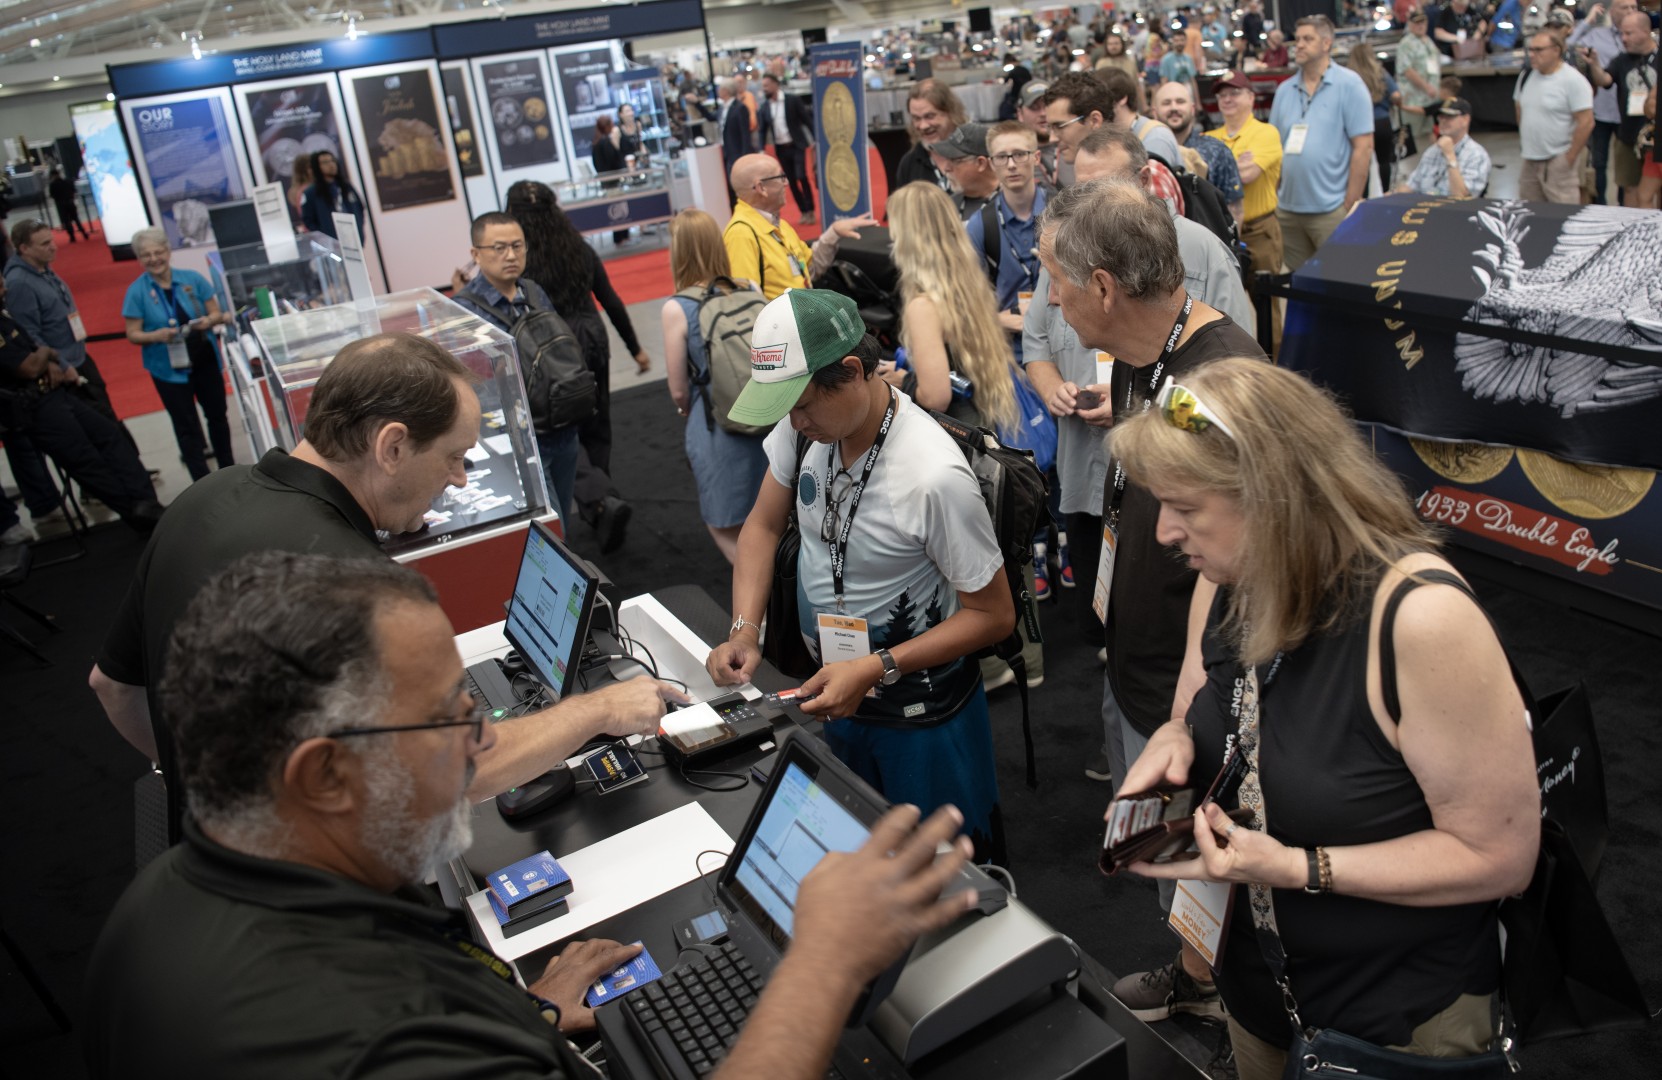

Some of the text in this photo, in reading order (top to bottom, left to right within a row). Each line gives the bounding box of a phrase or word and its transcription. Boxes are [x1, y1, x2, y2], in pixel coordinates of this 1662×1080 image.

[232, 48, 322, 68] THE HOLY LAND MINT
[139, 107, 173, 123] OUR
[1169, 323, 1183, 351] PMG
[1152, 362, 1165, 389] NGC
[1142, 399, 1151, 414] MG
[880, 412, 894, 435] NGC
[865, 449, 880, 472] PMG
[852, 484, 865, 507] NGC
[840, 521, 851, 543] PMG
[1414, 489, 1620, 572] 1933 Double Eagle
[829, 544, 837, 567] PMG
[836, 556, 844, 578] NGC
[1233, 678, 1244, 708] NGC
[1182, 911, 1207, 940] MONEY
